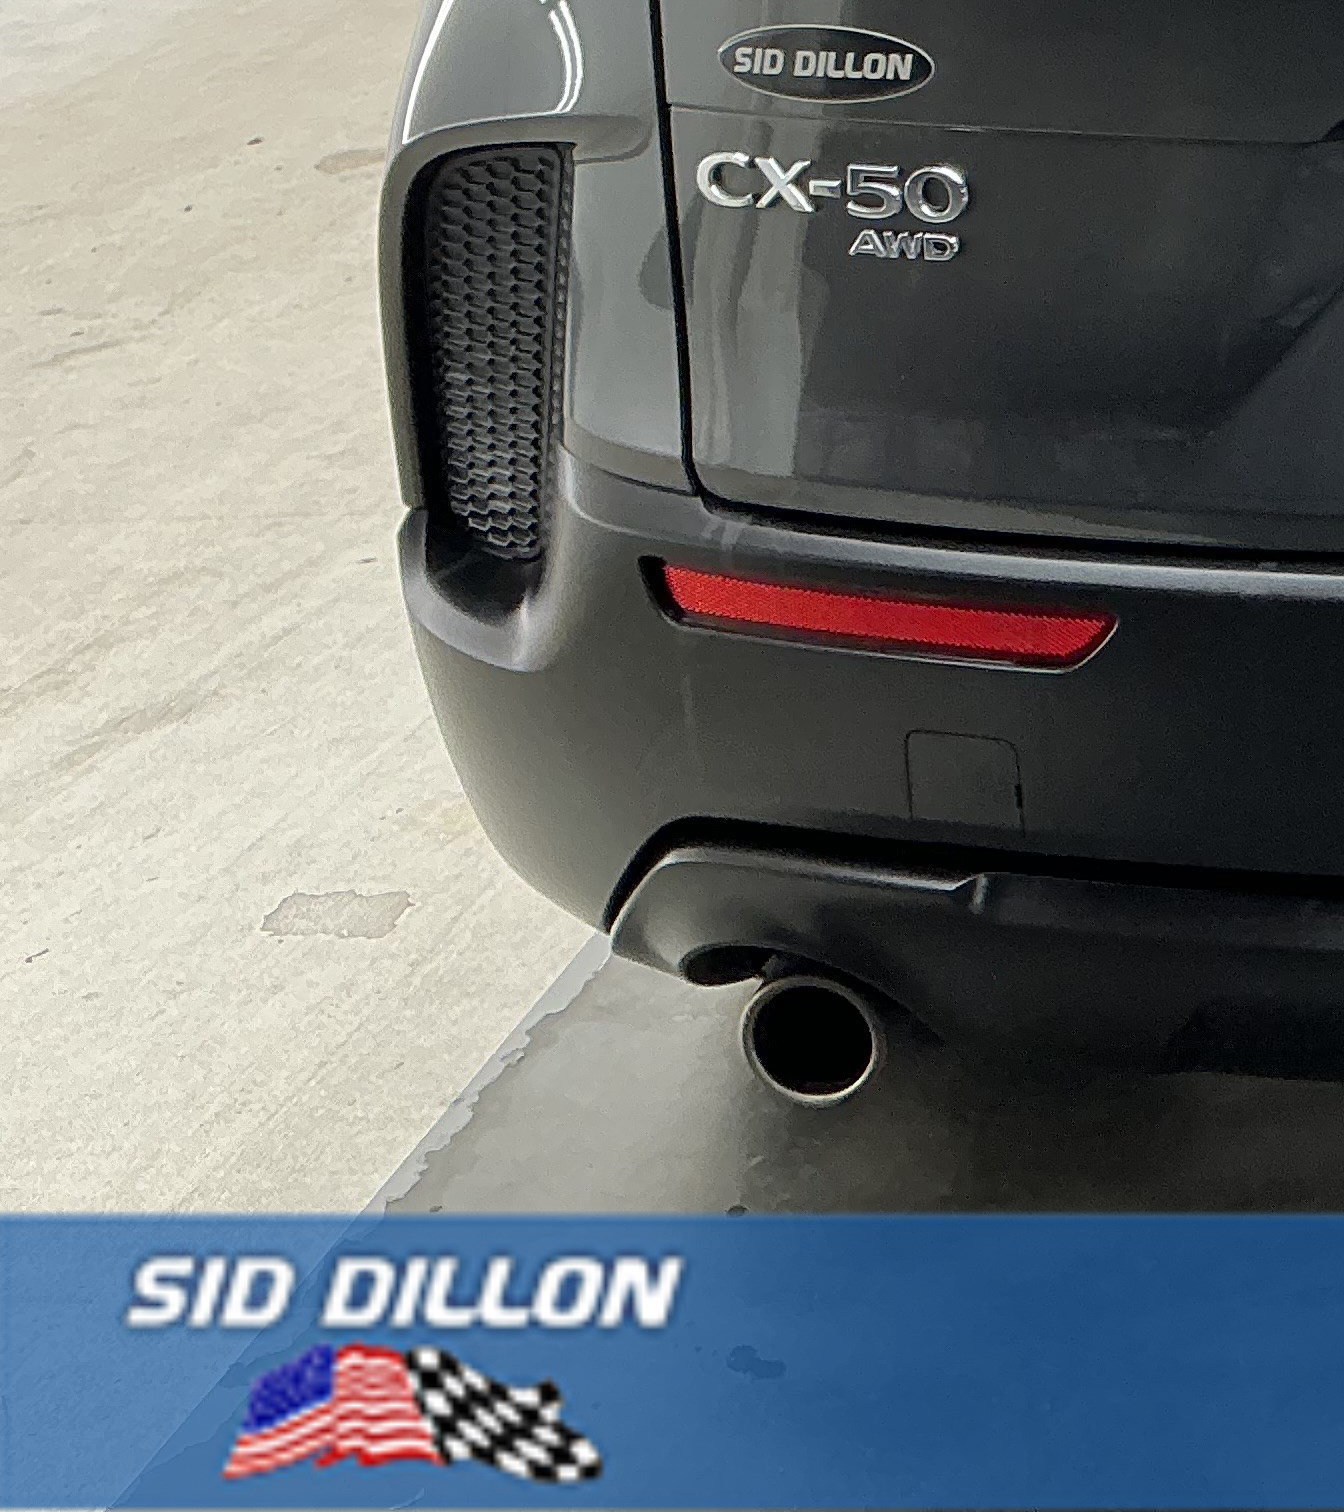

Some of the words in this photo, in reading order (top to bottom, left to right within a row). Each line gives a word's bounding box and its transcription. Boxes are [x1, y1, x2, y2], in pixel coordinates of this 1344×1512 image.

[733, 47, 785, 75] SID
[793, 50, 913, 80] DILLON
[697, 151, 969, 224] CX-50
[849, 229, 959, 261] AWD
